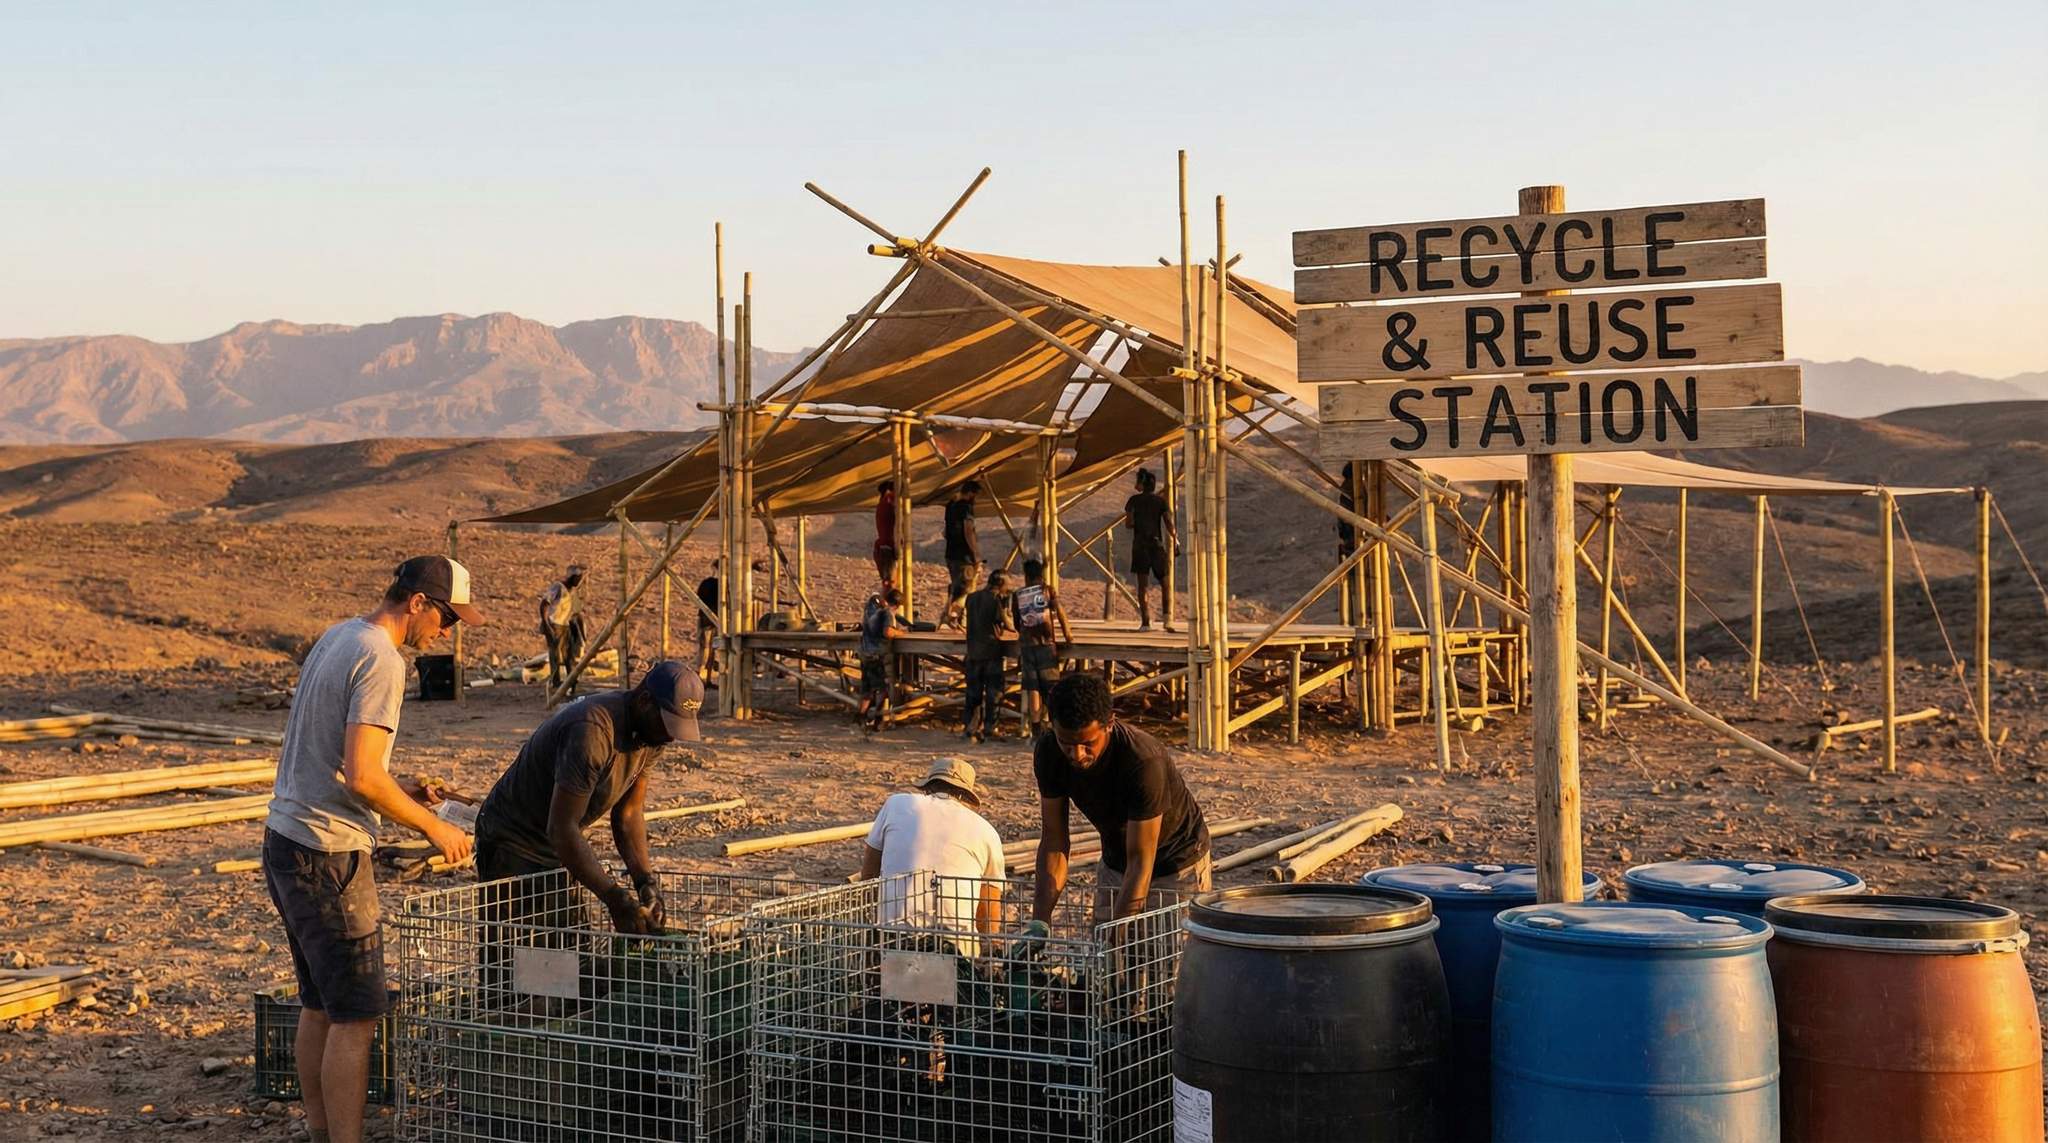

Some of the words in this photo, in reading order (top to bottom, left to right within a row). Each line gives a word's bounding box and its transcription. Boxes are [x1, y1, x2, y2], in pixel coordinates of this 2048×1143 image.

[1368, 211, 1686, 294] RECYCLE
[1381, 311, 1431, 372] &
[1465, 295, 1697, 370] REUSE
[1389, 376, 1699, 451] STATION
